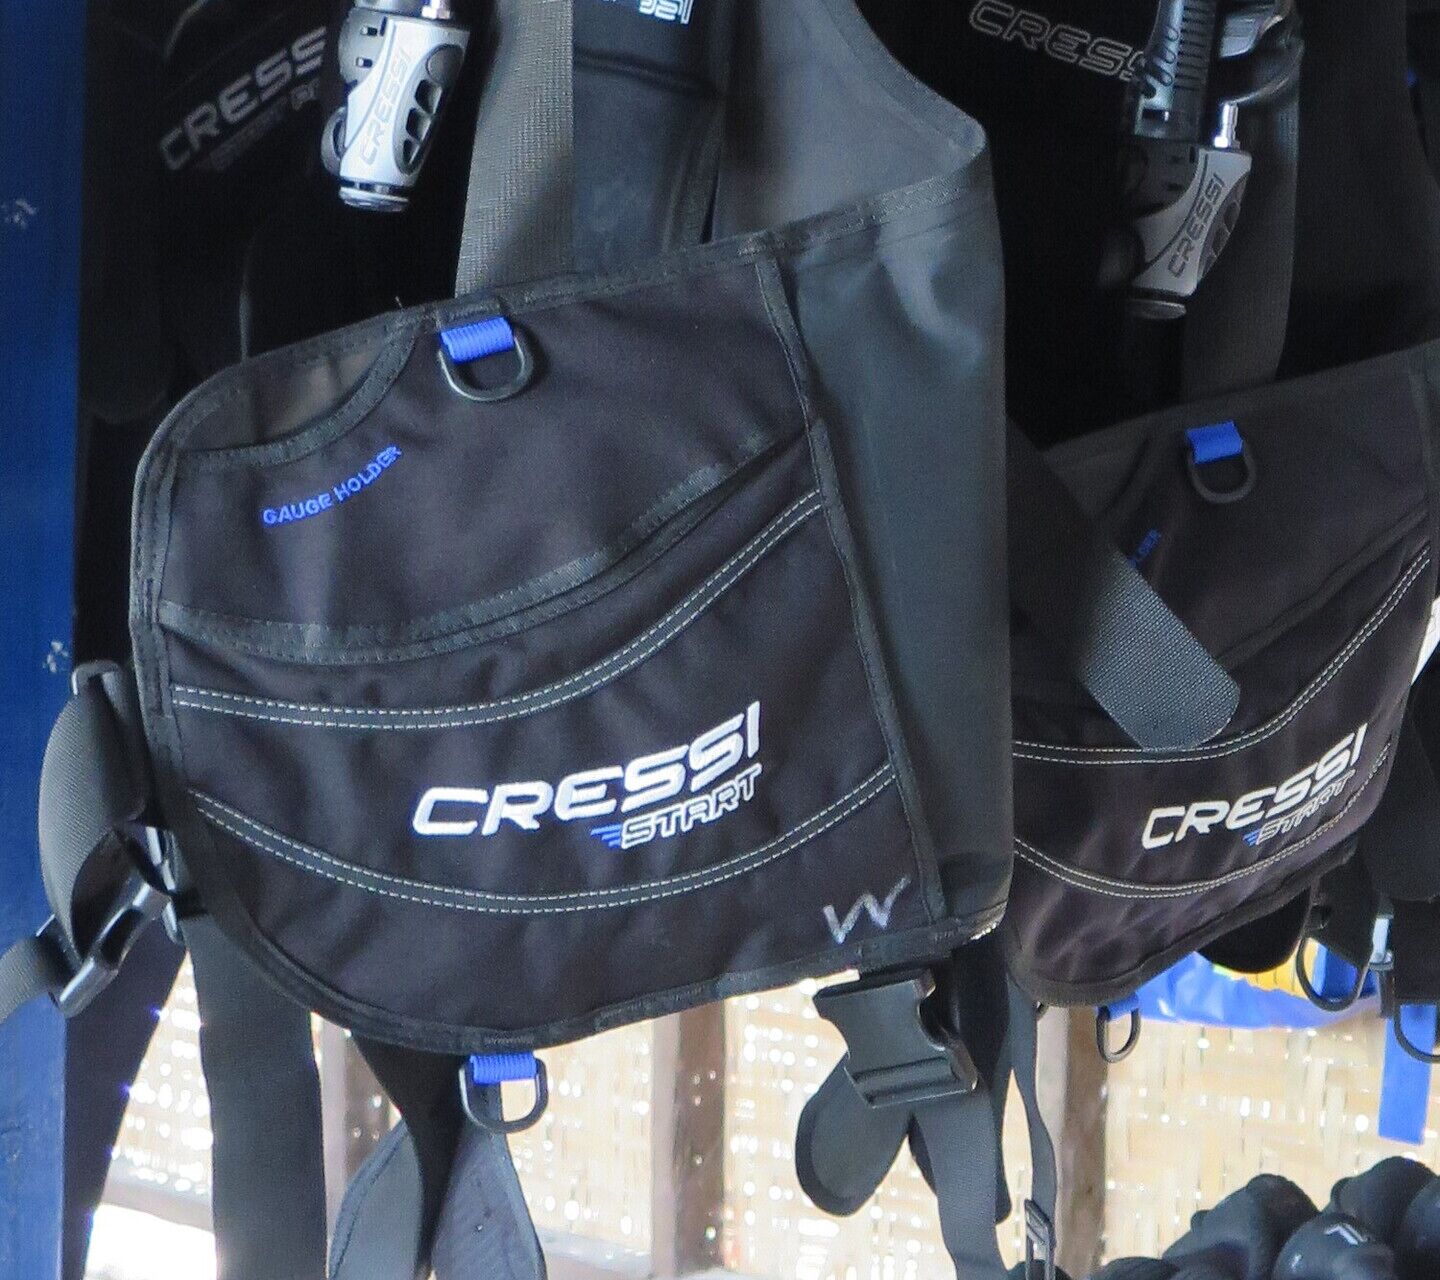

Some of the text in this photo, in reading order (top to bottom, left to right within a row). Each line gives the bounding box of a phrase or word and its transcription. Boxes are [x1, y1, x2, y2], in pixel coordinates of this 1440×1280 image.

[160, 25, 328, 170] CRESS
[262, 445, 402, 525] GAUGE HOLDER
[412, 700, 761, 837] CRESSI
[620, 763, 763, 850] START
[1141, 722, 1368, 850] CRESSI
